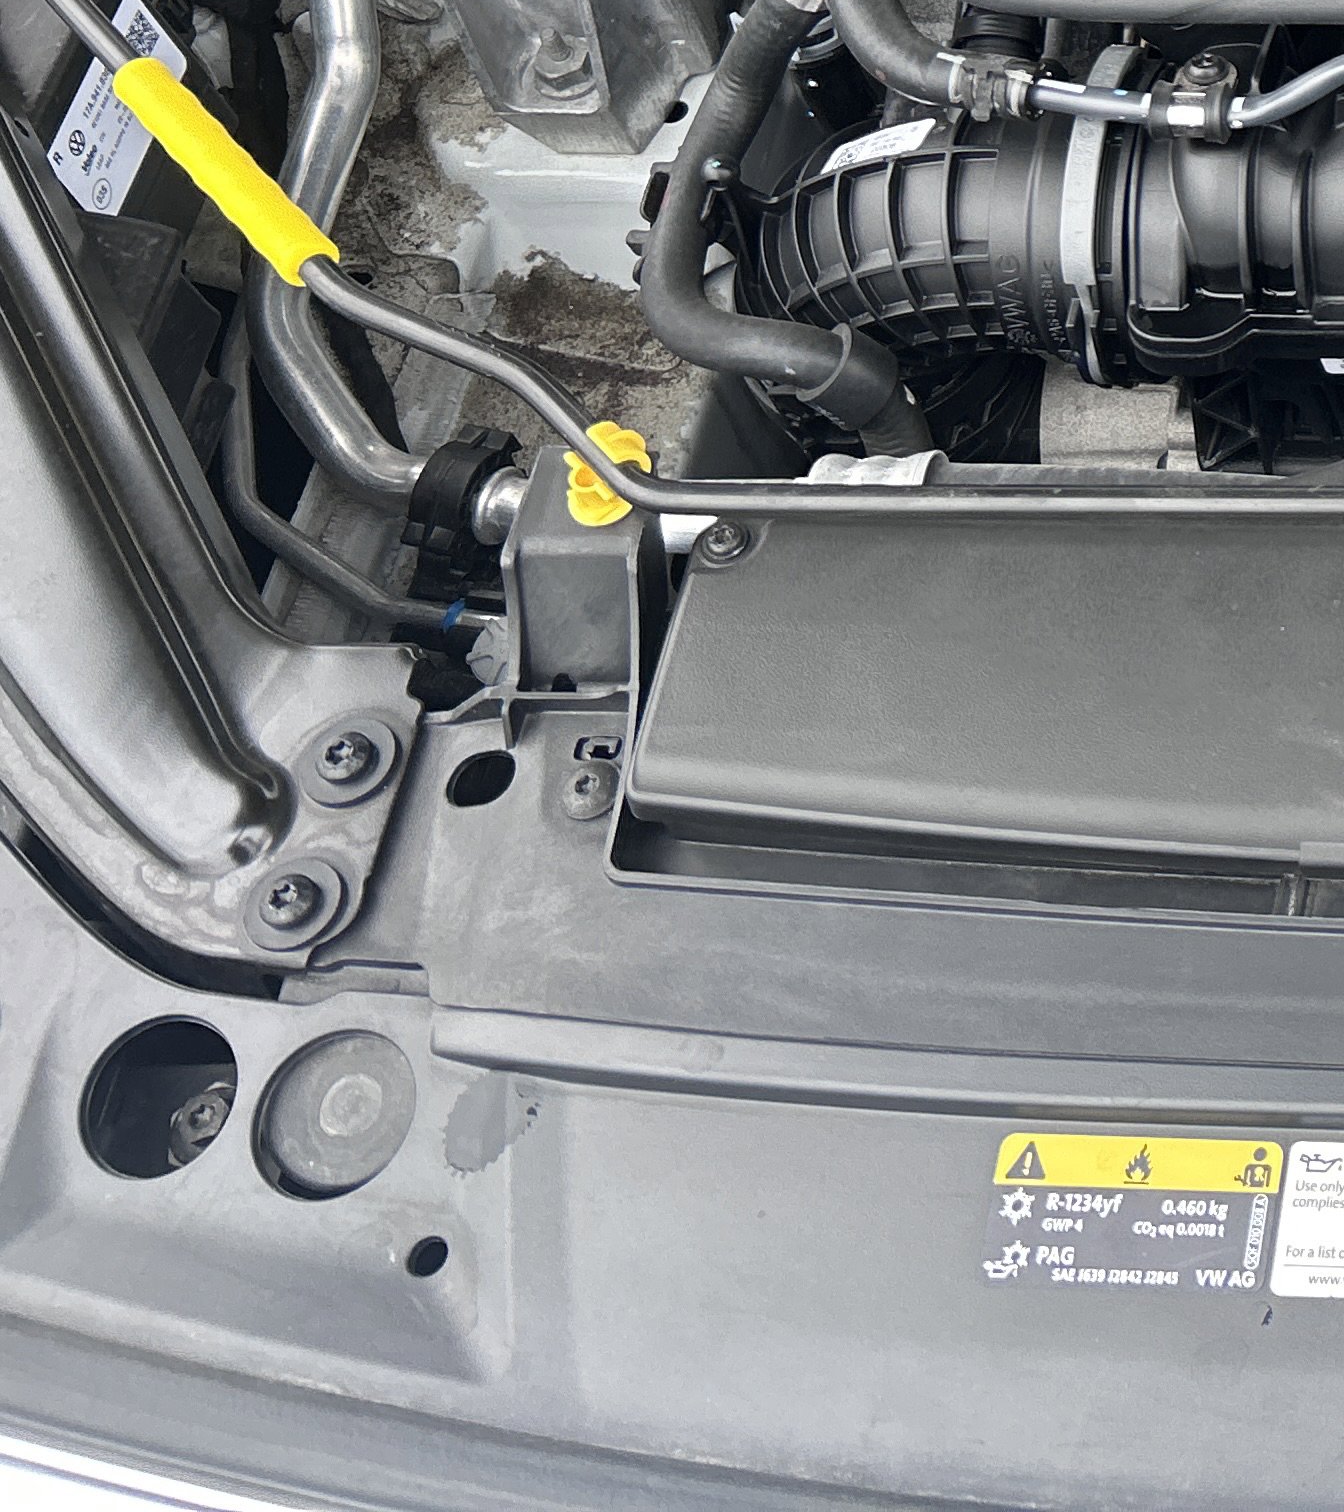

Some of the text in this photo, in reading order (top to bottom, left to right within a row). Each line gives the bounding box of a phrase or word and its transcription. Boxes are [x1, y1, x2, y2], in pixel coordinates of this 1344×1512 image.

[52, 151, 64, 166] R
[1295, 1180, 1317, 1191] Use
[1320, 1181, 1344, 1195] only
[1046, 1193, 1228, 1222] R-1234yf 0.460 kg
[1293, 1197, 1344, 1211] complies
[1036, 1245, 1075, 1265] PAG
[1286, 1246, 1305, 1257] For
[1308, 1248, 1315, 1257] a
[1318, 1246, 1336, 1258] list
[1195, 1269, 1256, 1288] VW AG
